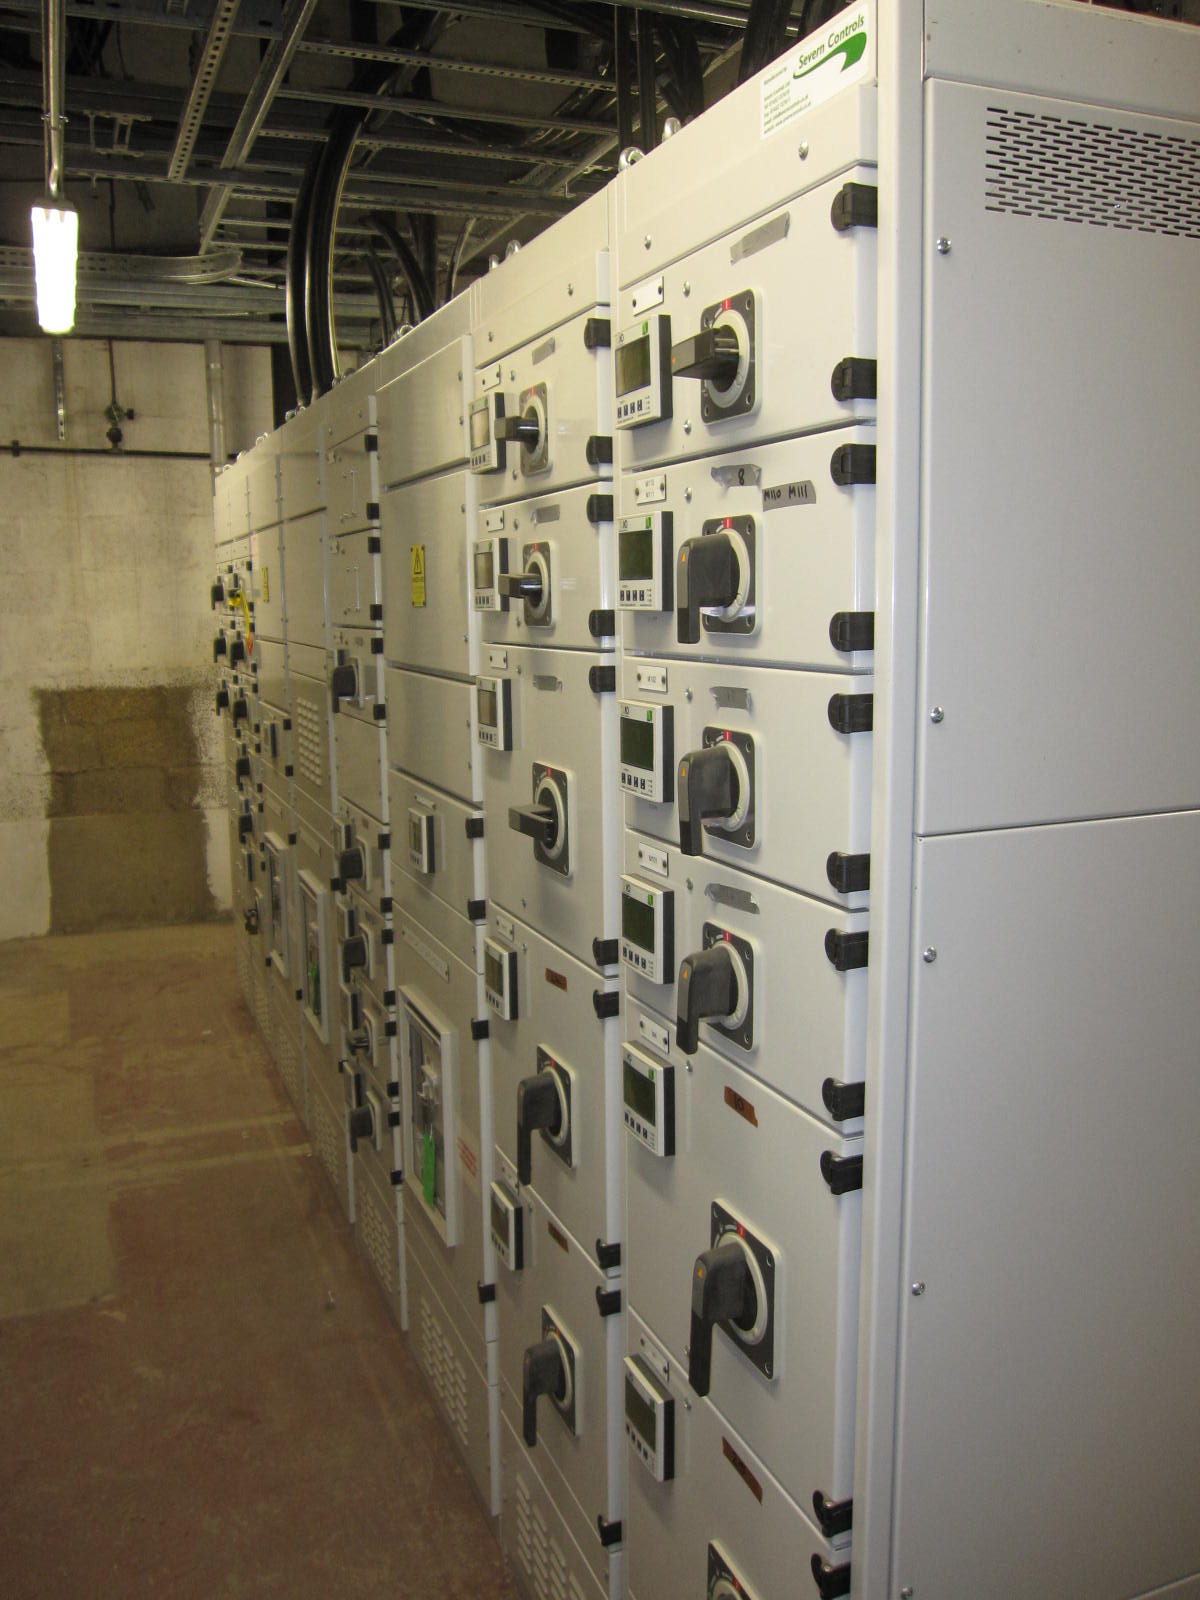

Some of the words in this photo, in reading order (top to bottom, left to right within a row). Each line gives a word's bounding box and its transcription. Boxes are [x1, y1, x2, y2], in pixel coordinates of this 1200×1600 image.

[798, 43, 825, 69] Severn
[827, 13, 864, 48] Controls
[738, 467, 745, 486] 8
